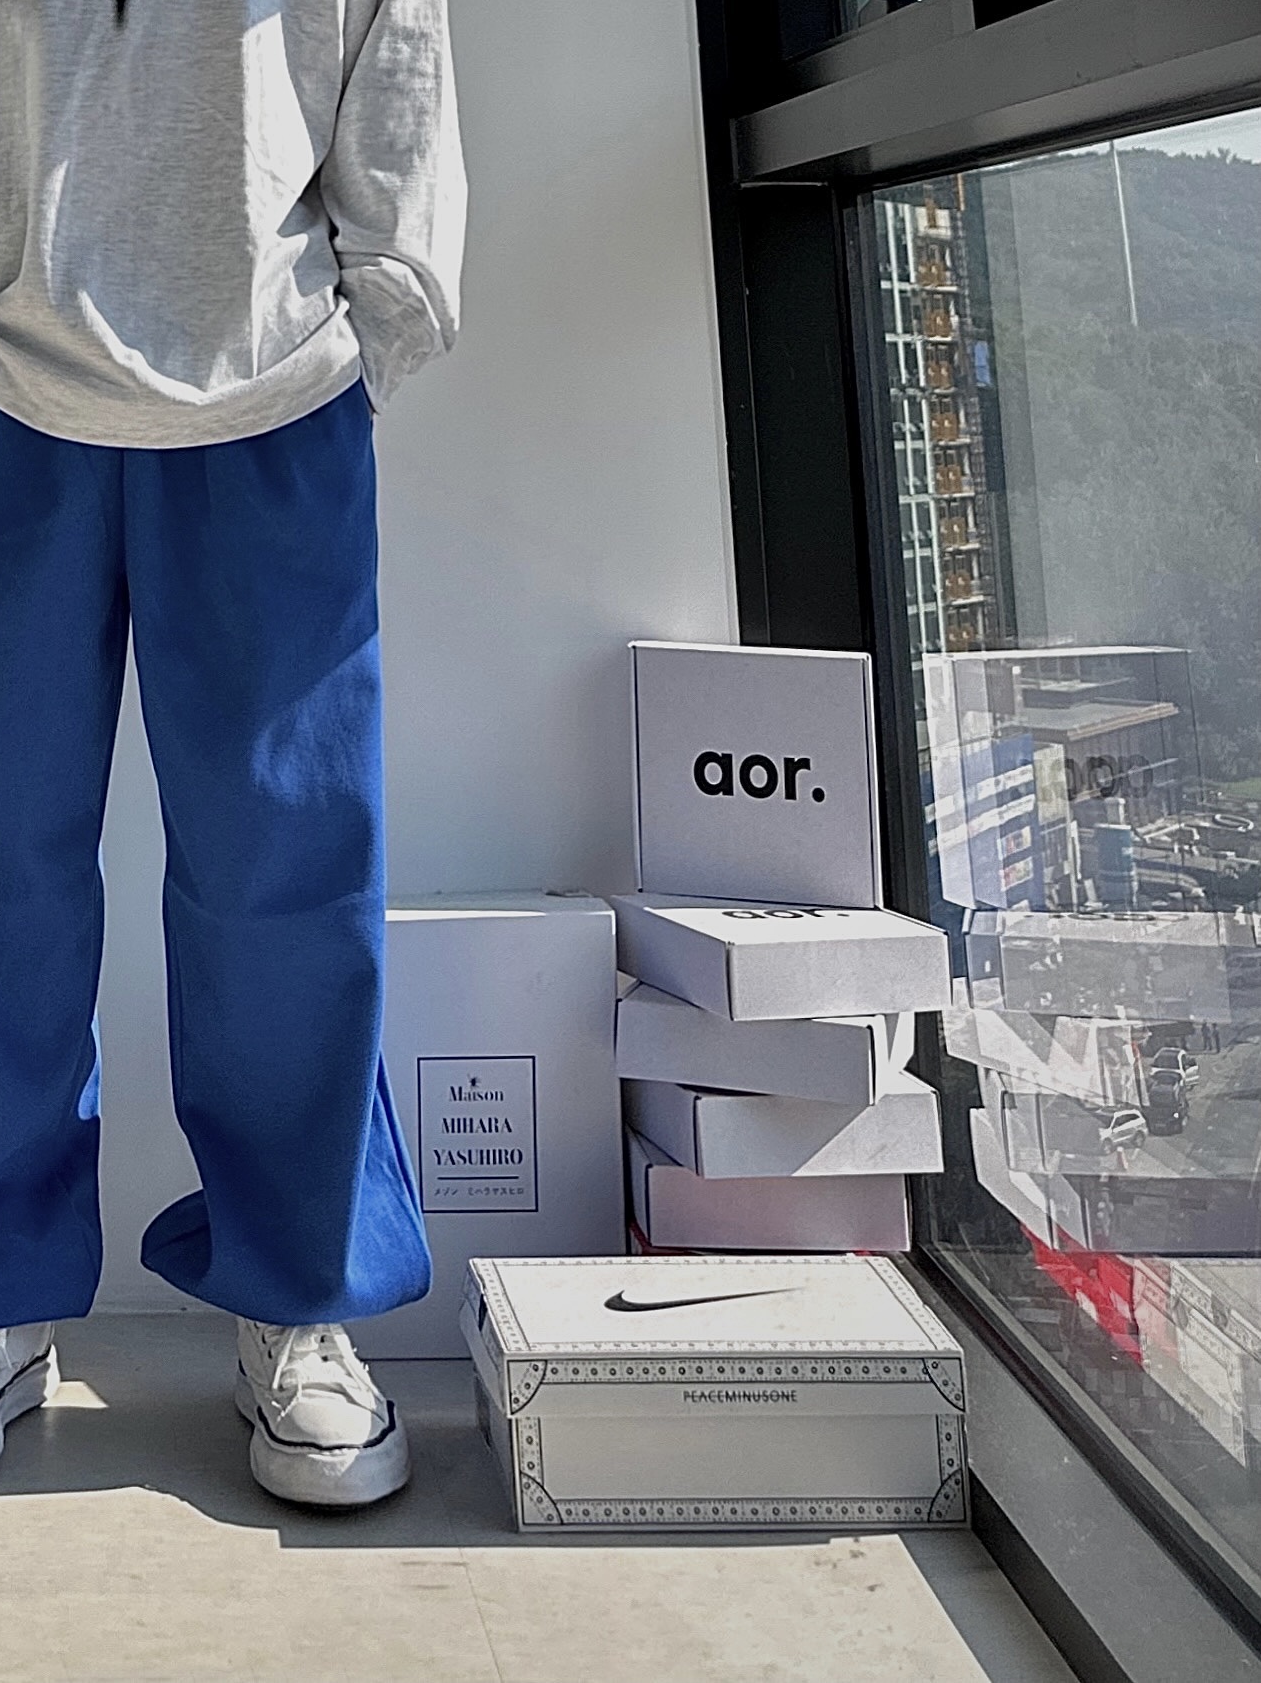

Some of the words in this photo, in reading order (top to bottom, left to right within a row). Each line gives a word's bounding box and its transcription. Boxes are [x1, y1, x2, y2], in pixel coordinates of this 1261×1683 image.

[693, 750, 826, 803] aor.
[449, 1086, 504, 1102] Maison
[442, 1118, 513, 1134] MIHARA
[433, 1149, 523, 1165] YASUHIRO
[683, 1389, 798, 1404] PEACEMINUSONE
